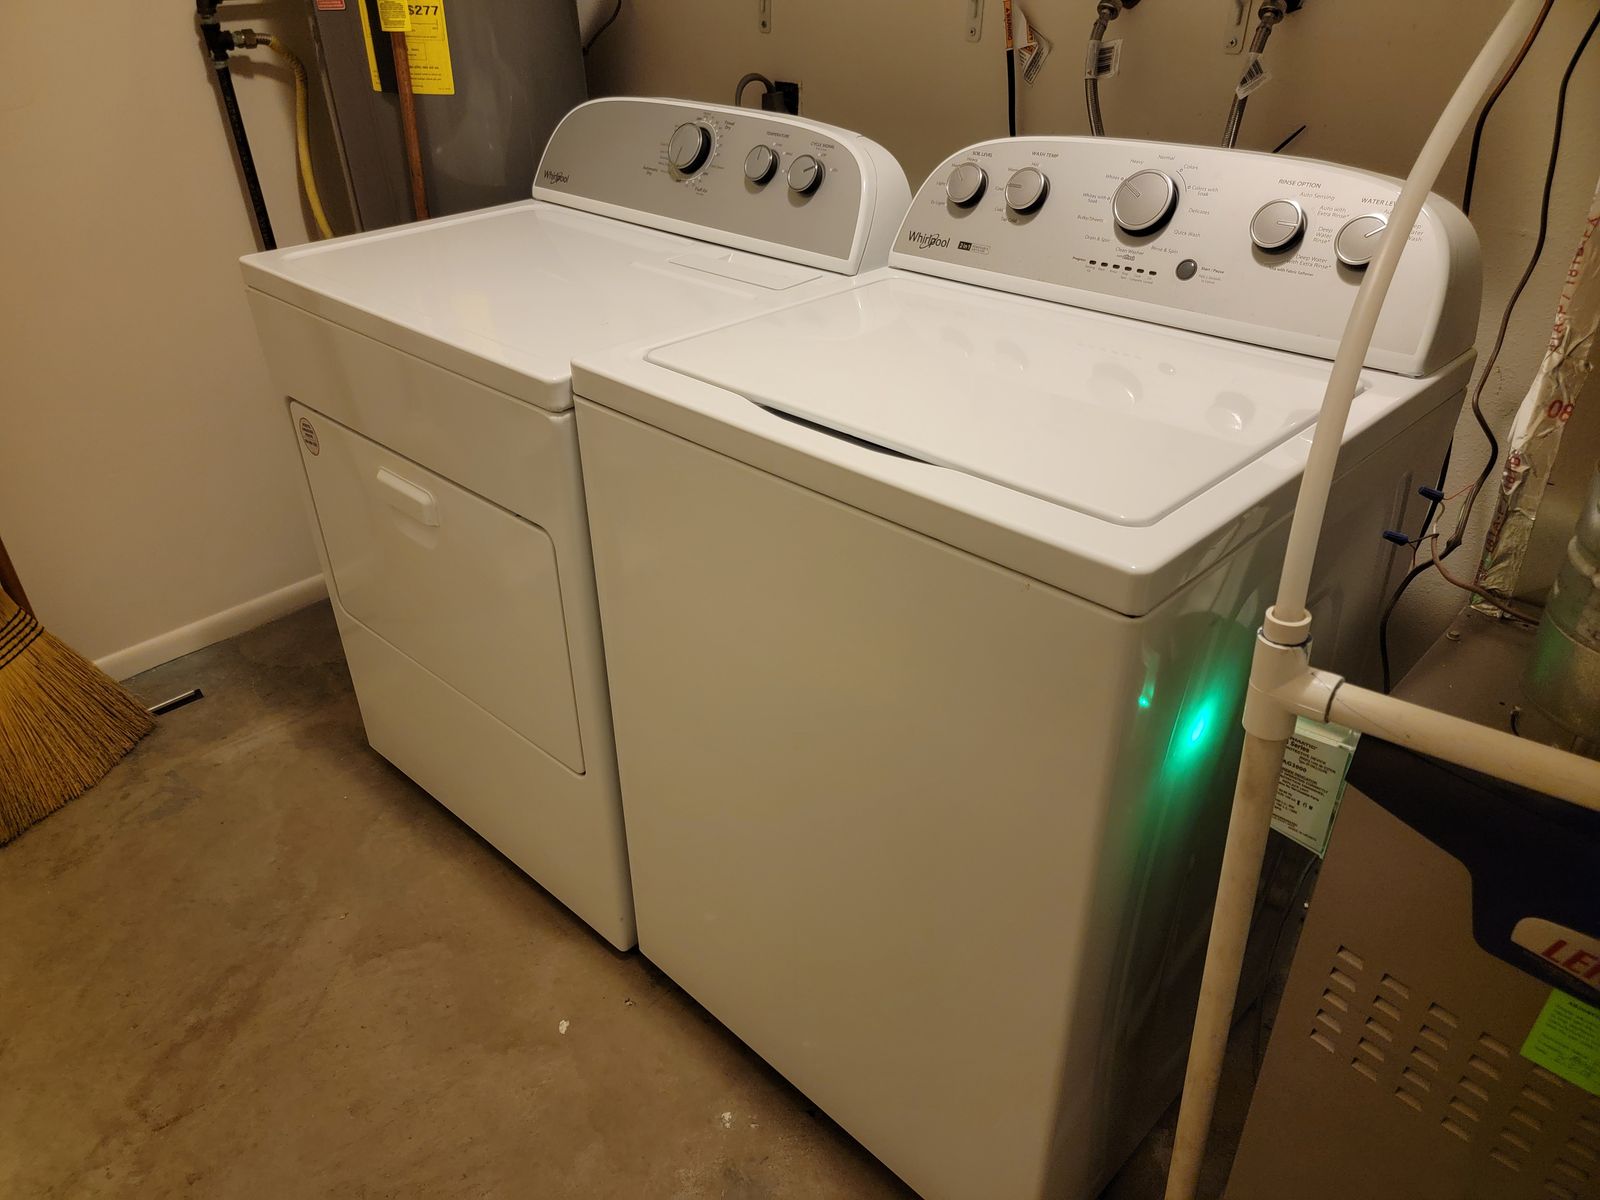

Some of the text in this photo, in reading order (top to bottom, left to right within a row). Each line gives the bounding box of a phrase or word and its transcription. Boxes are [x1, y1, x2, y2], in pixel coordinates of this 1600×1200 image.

[407, 4, 439, 16] $277
[1278, 178, 1322, 189] RINSE OPTION
[1313, 193, 1335, 201] Sensing
[1361, 198, 1385, 206] WATER
[1316, 210, 1331, 218] Extra
[1317, 226, 1334, 234] Deep
[1315, 231, 1333, 240] Water
[908, 230, 951, 250] Whirlpool
[1299, 260, 1313, 268] Extra
[1311, 256, 1328, 264] Water
[1289, 740, 1310, 754] Series
